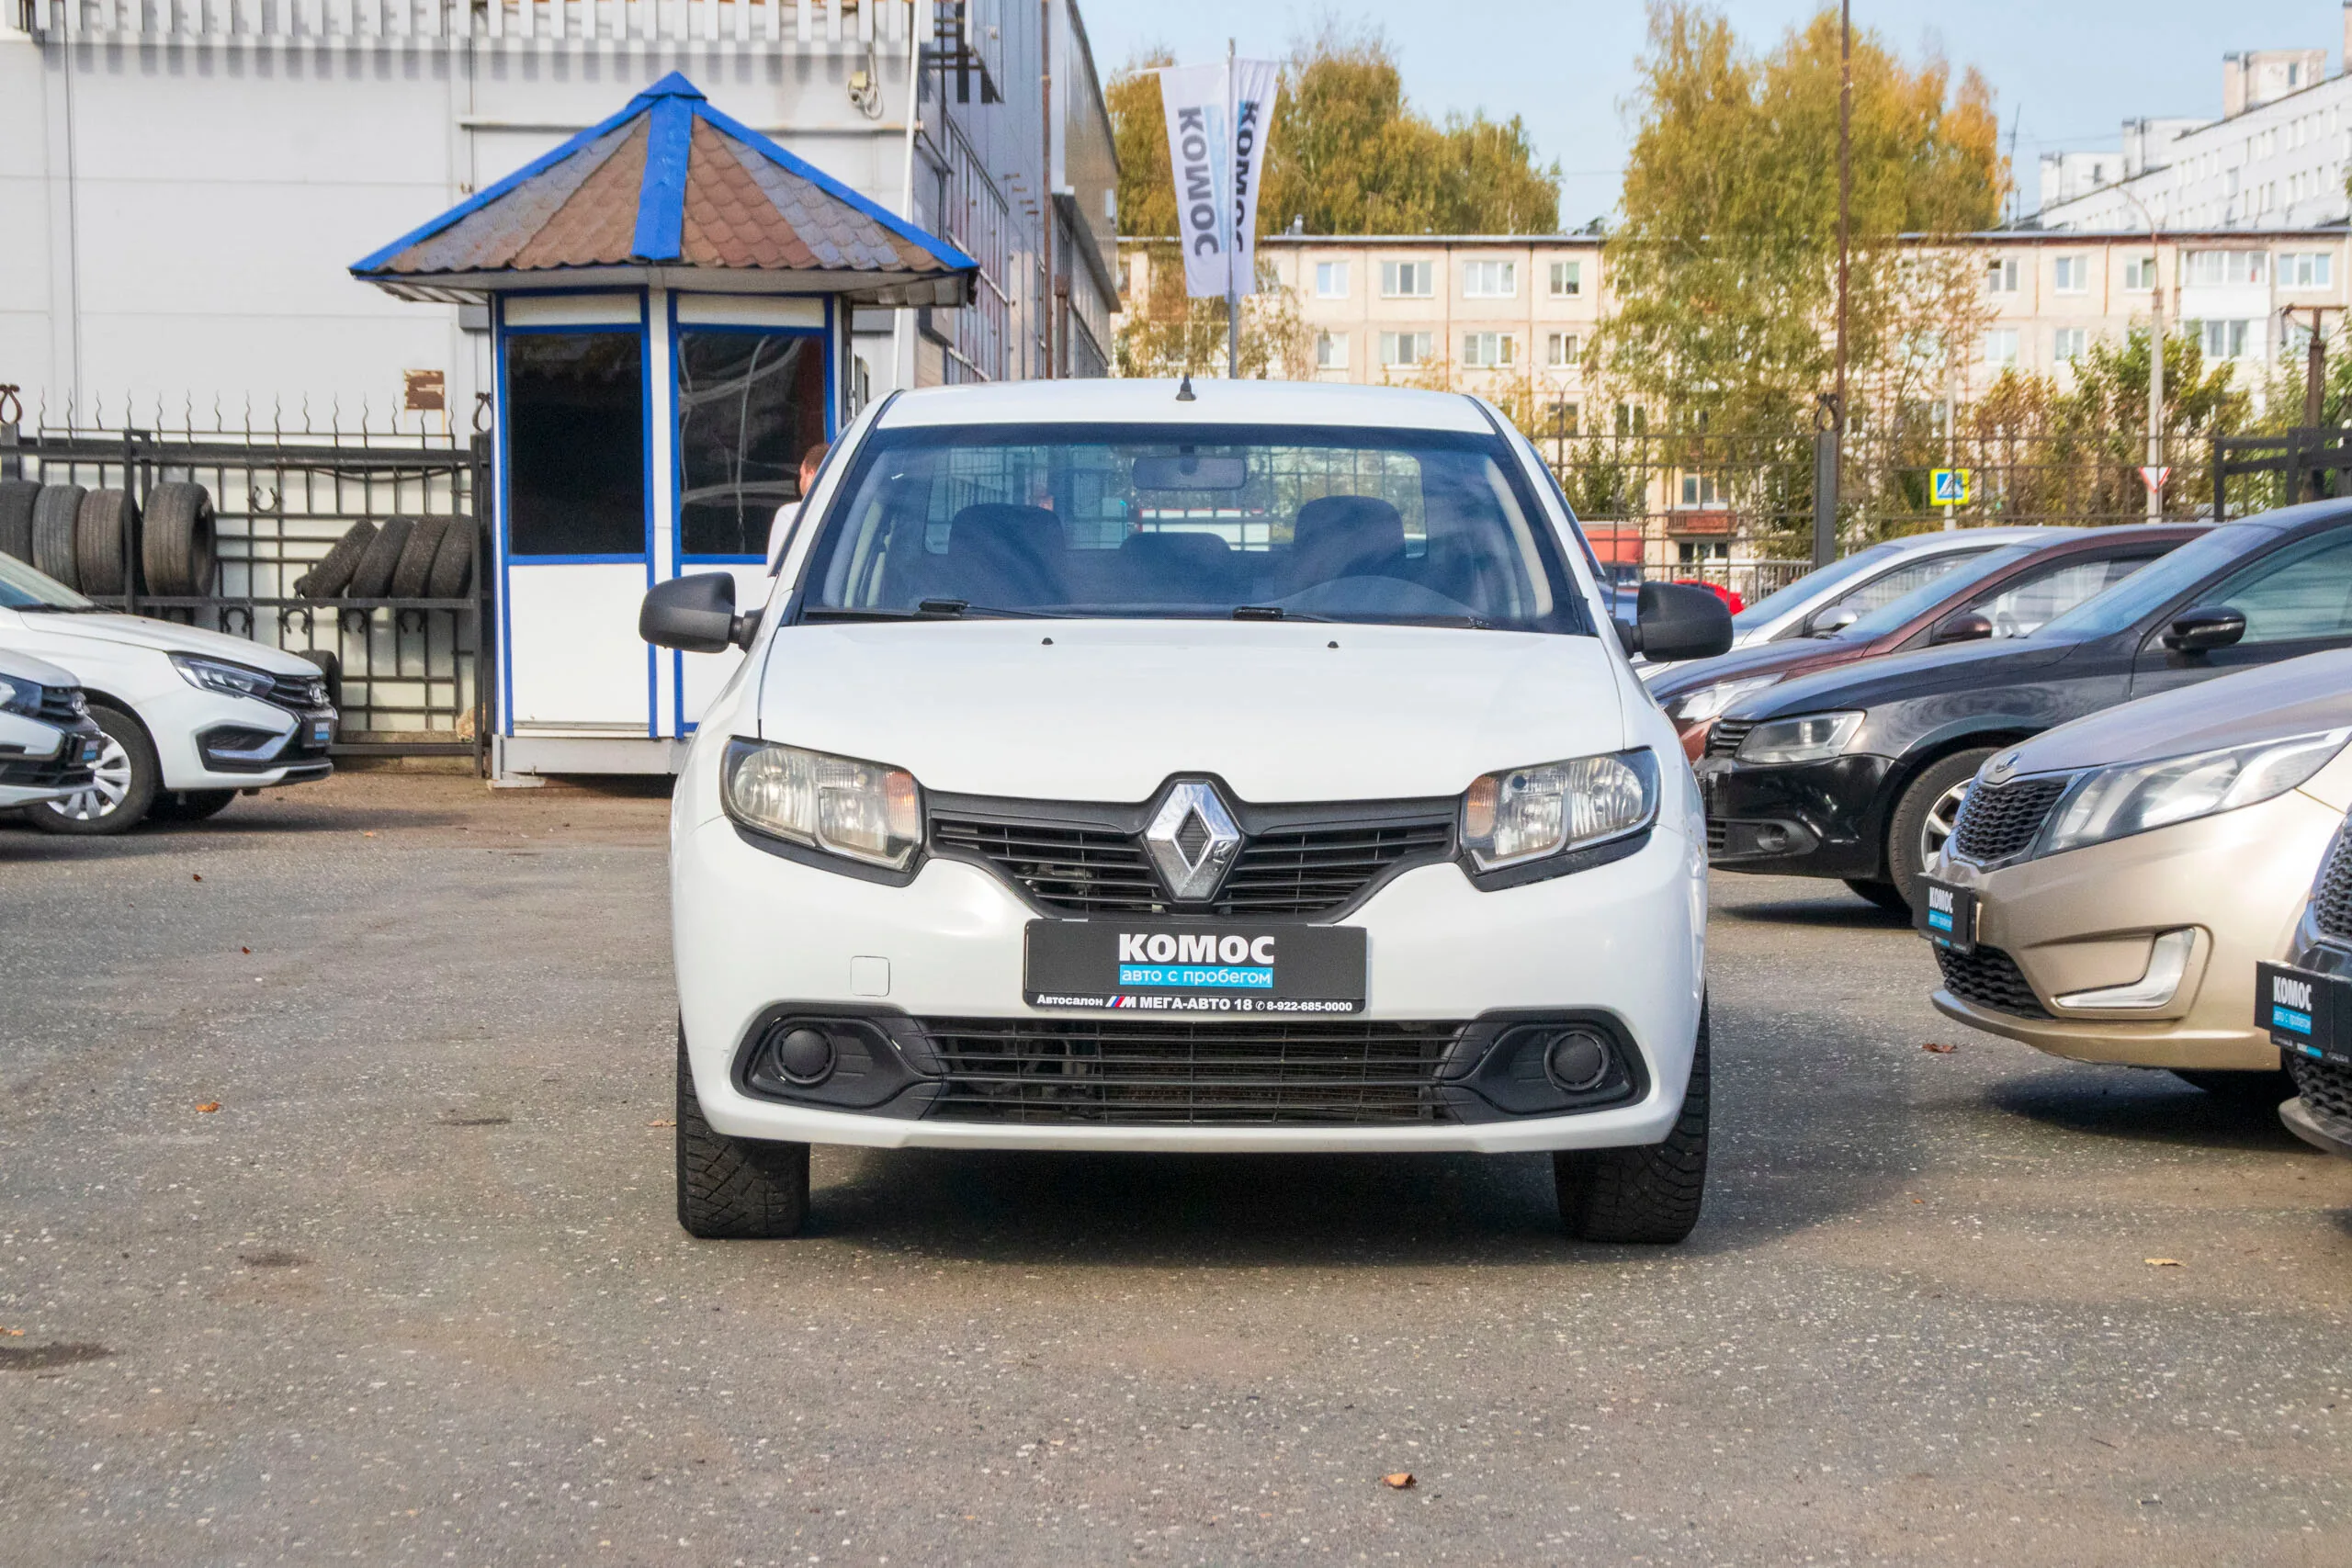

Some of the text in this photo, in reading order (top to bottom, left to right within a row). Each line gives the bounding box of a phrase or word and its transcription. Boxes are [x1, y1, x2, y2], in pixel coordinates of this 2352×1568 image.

[1119, 933, 1274, 964] КОМОС
[1122, 968, 1271, 986] авто с пробегом
[1036, 994, 1103, 1007] Автосалон
[1139, 997, 1230, 1010] МЕГА-АВТО
[1234, 998, 1253, 1011] 18
[1266, 1001, 1353, 1011] 8-922-685-0000
[2273, 976, 2312, 1011] КОМОС
